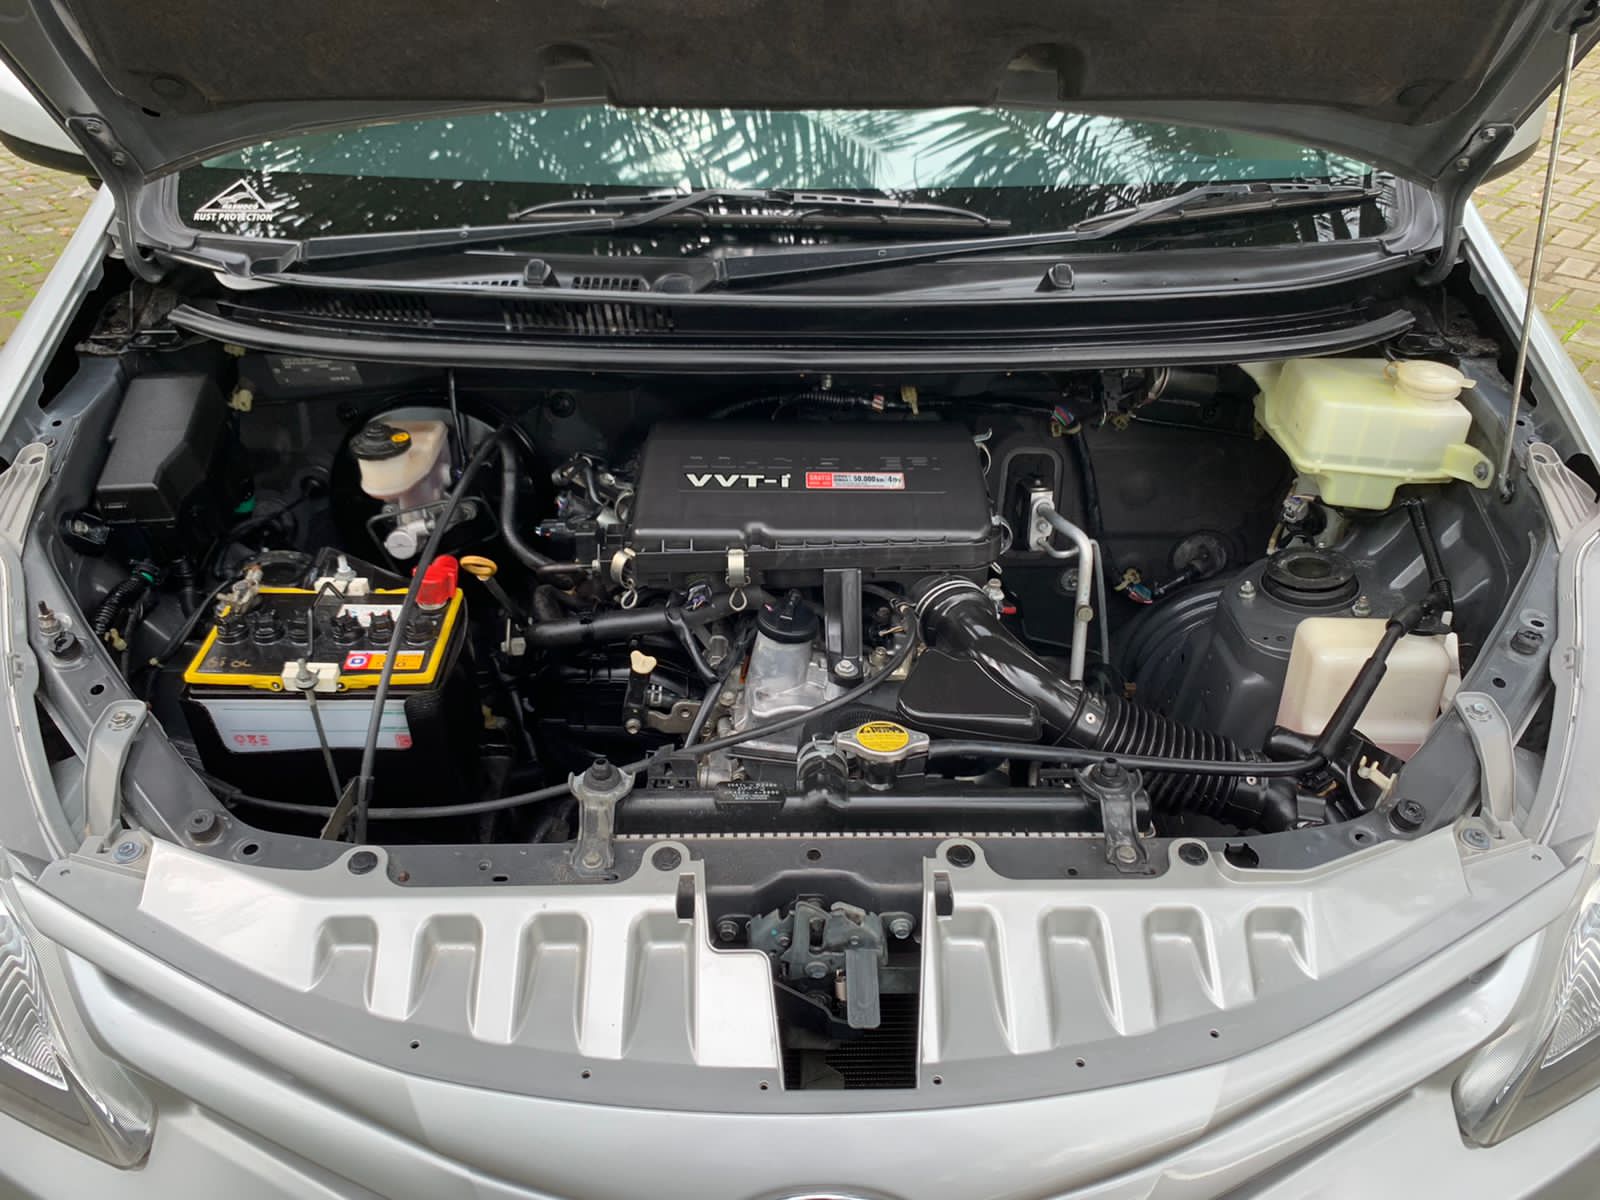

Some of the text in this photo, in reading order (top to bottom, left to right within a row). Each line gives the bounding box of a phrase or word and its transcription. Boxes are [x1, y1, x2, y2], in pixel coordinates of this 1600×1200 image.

[193, 213, 273, 222] RUST PROTECTION
[686, 473, 791, 488] VVT-i
